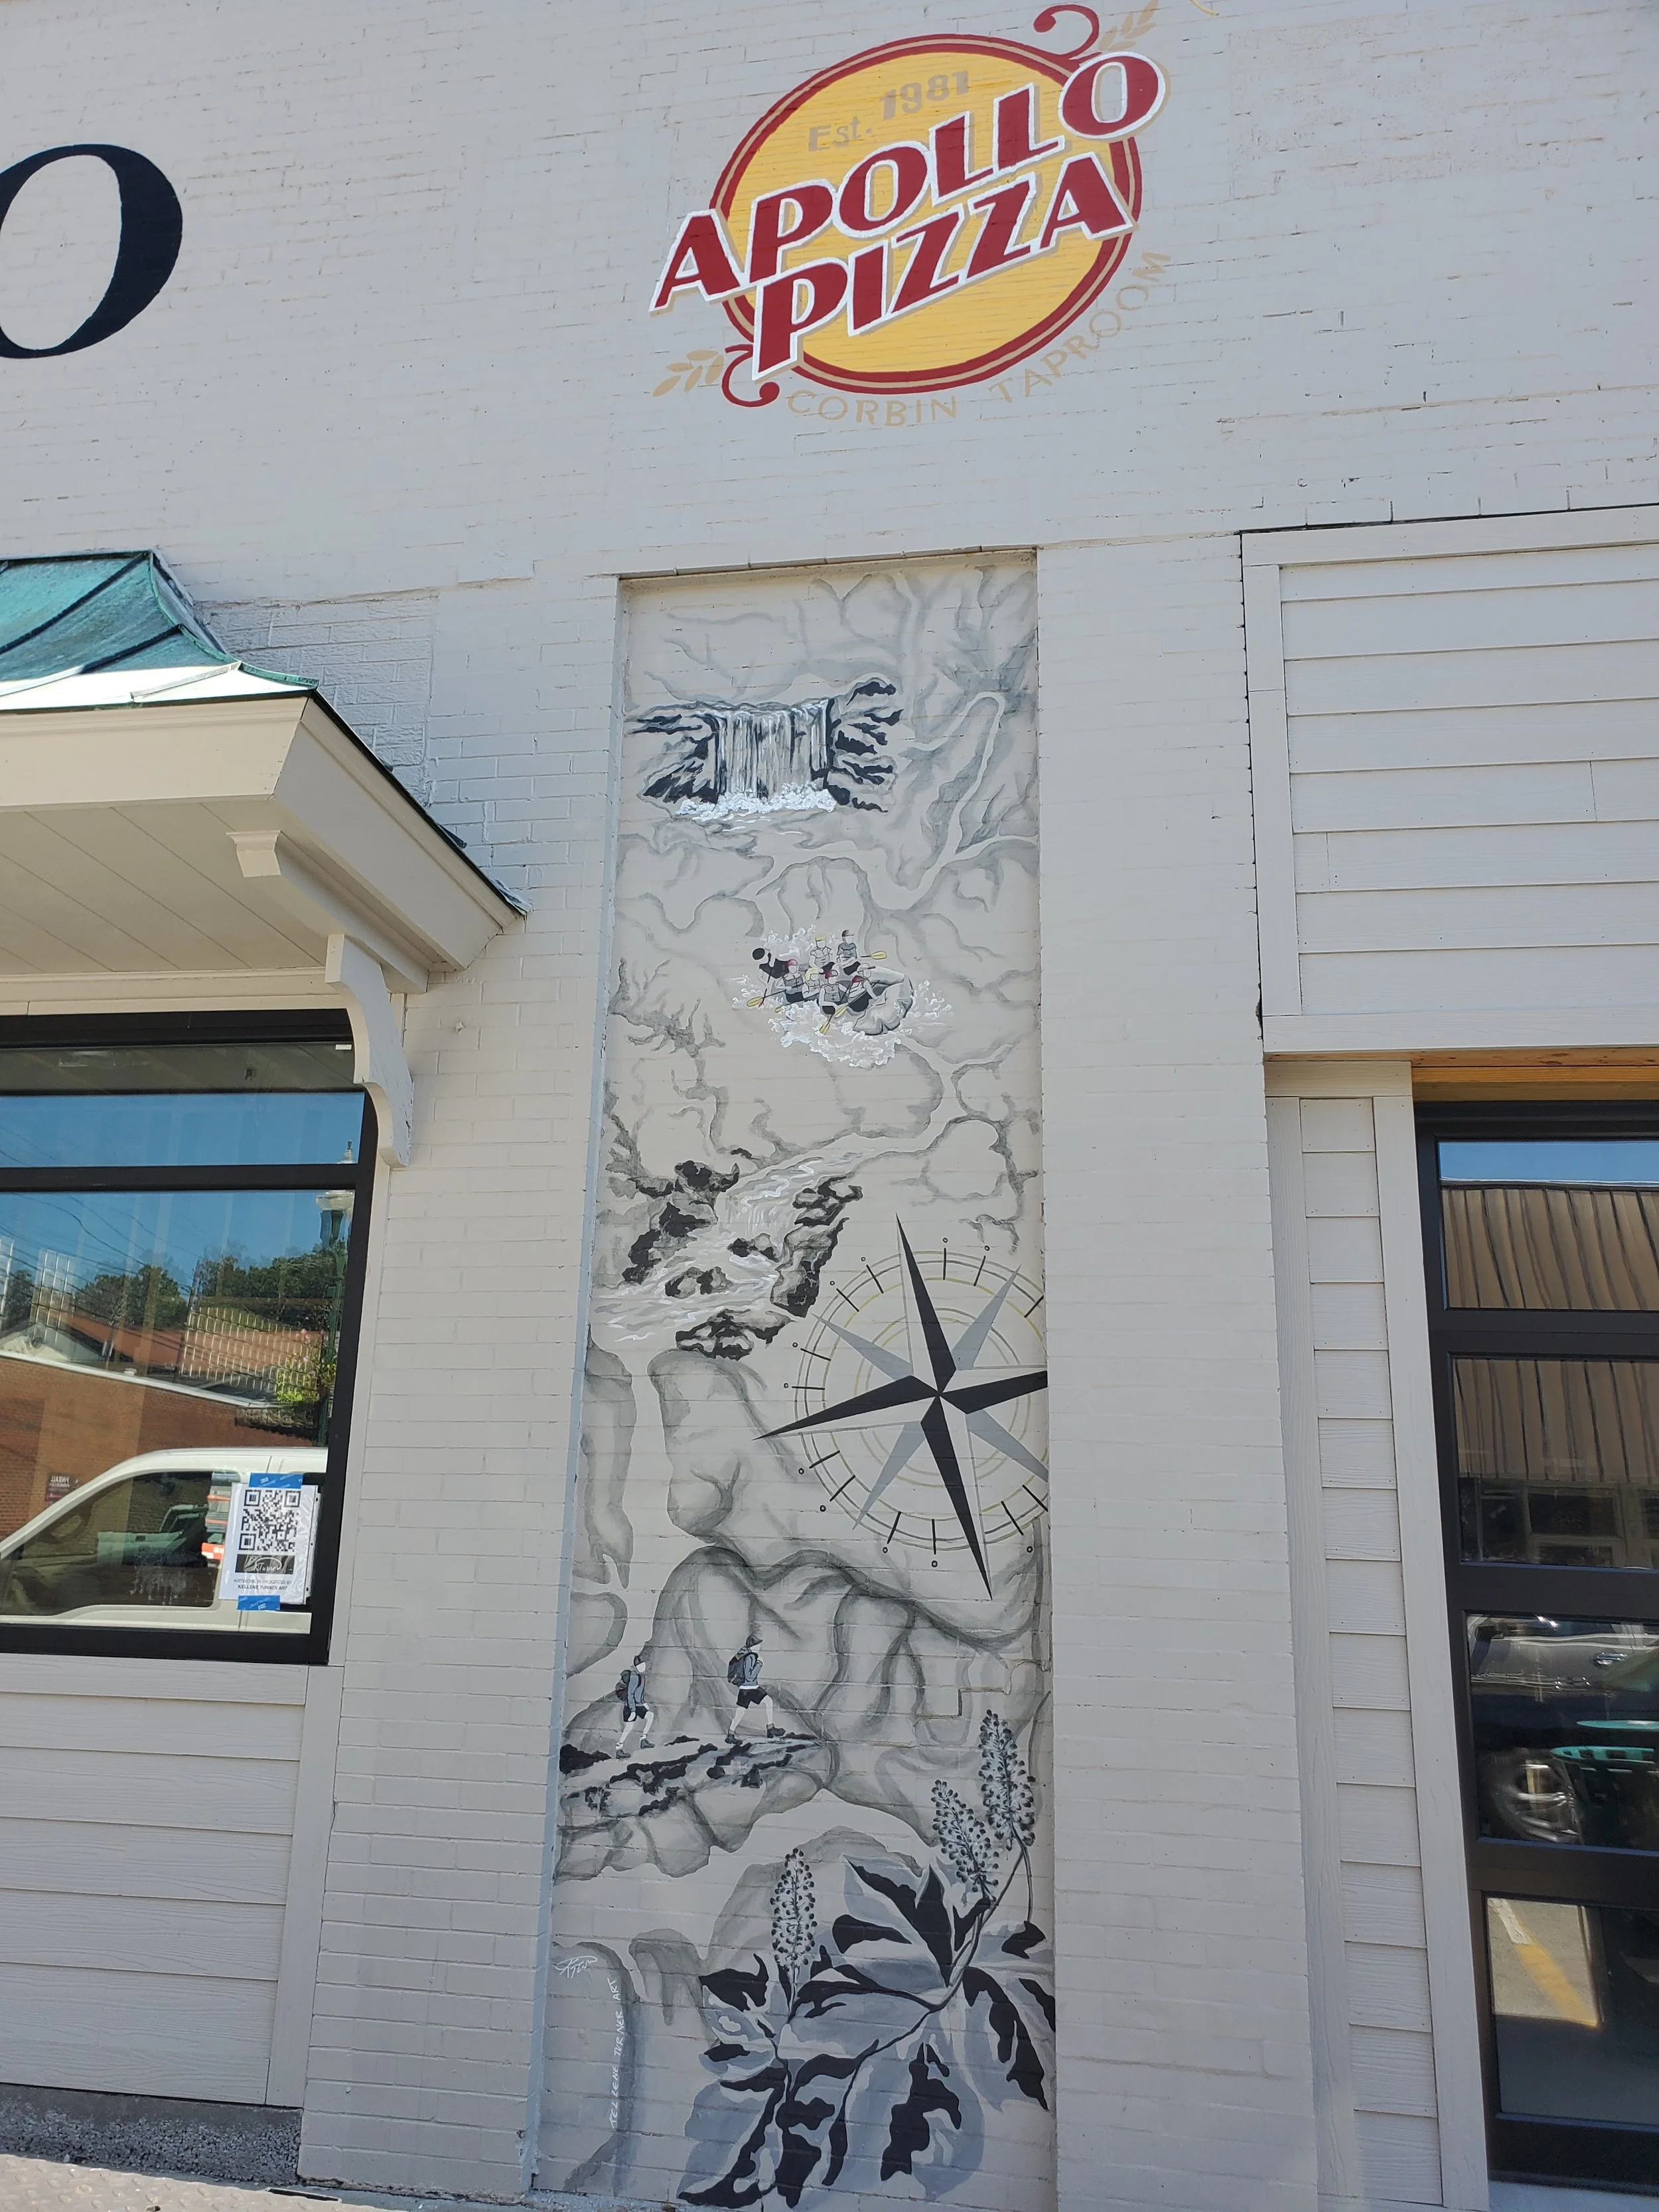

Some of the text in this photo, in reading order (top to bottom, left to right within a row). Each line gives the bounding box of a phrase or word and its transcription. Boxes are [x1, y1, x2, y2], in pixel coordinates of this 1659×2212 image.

[881, 71, 970, 121] 1981
[808, 116, 873, 153] Est.
[648, 52, 1167, 313] APOLLO
[751, 151, 1133, 382] PIZZA
[788, 252, 1171, 427] CORBIN TAPROOM
[607, 1977, 621, 2000] ART
[614, 2011, 625, 2056] TURNER
